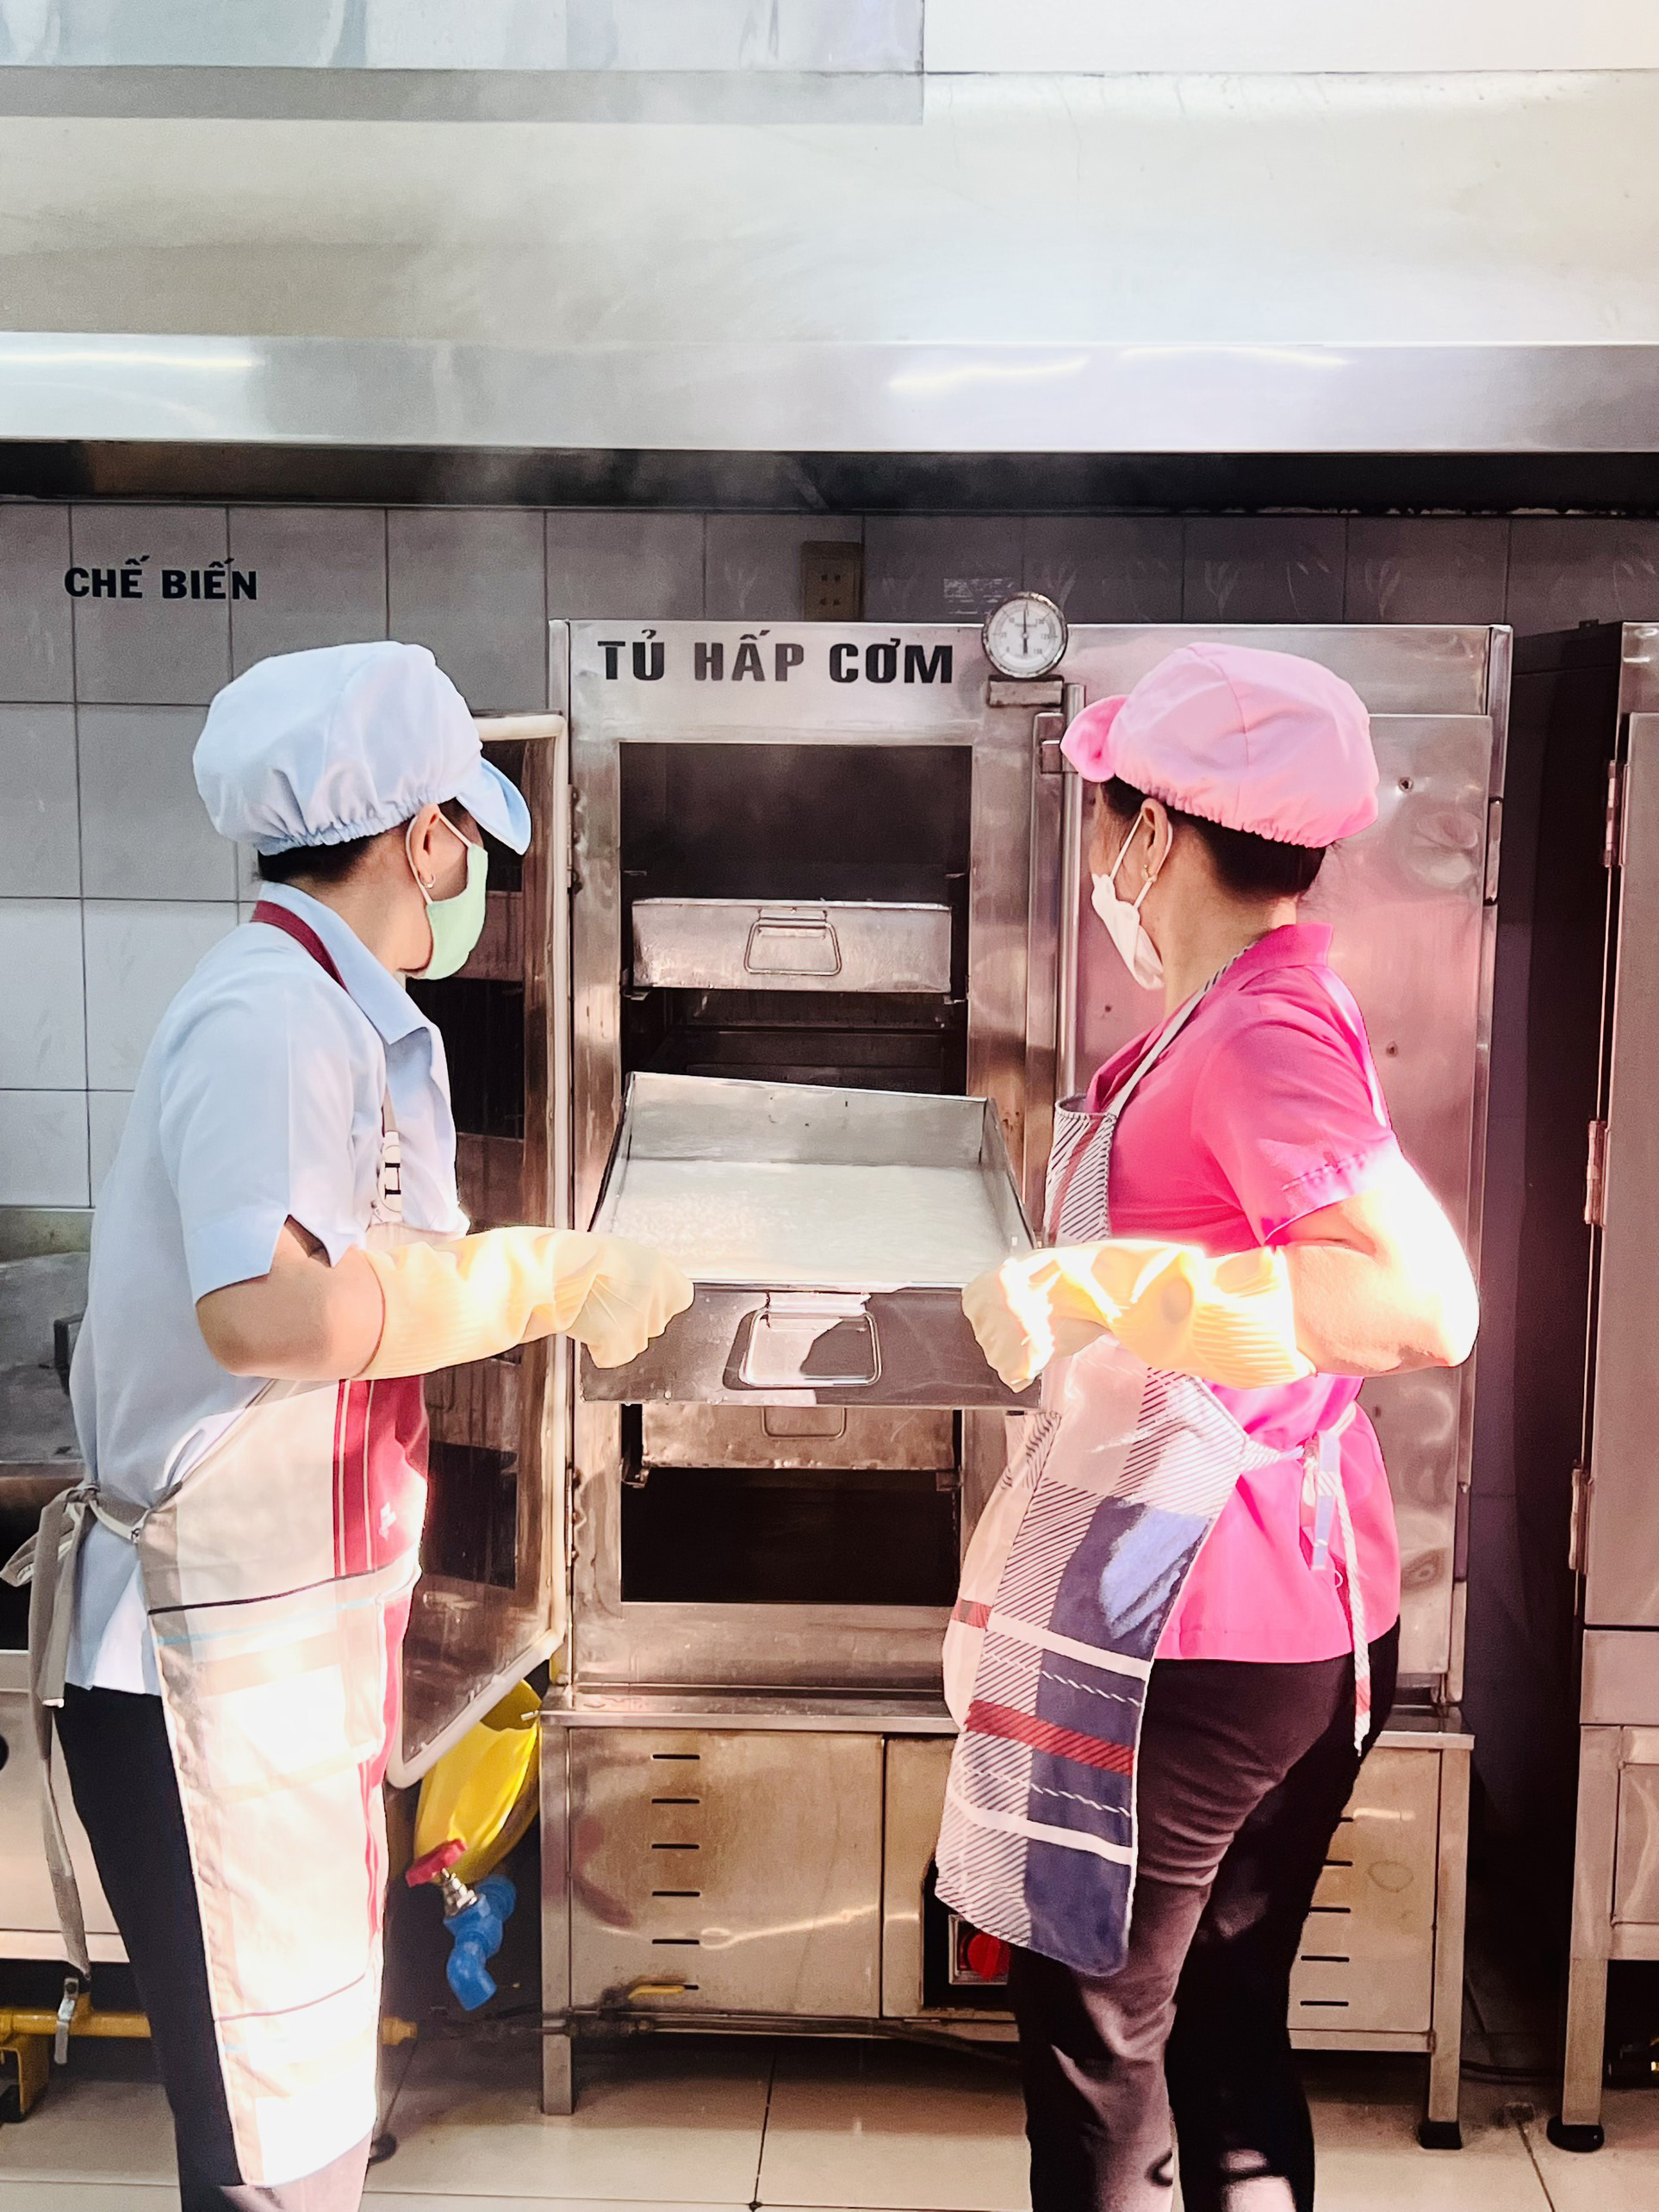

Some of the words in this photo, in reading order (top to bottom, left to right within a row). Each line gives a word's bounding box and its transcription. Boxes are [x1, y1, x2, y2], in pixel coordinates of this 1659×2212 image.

[64, 556, 150, 599] CHẾ
[162, 558, 257, 600] BIẾN
[598, 629, 665, 681] TỦ
[694, 630, 805, 682] HẤP
[830, 637, 953, 684] CƠM
